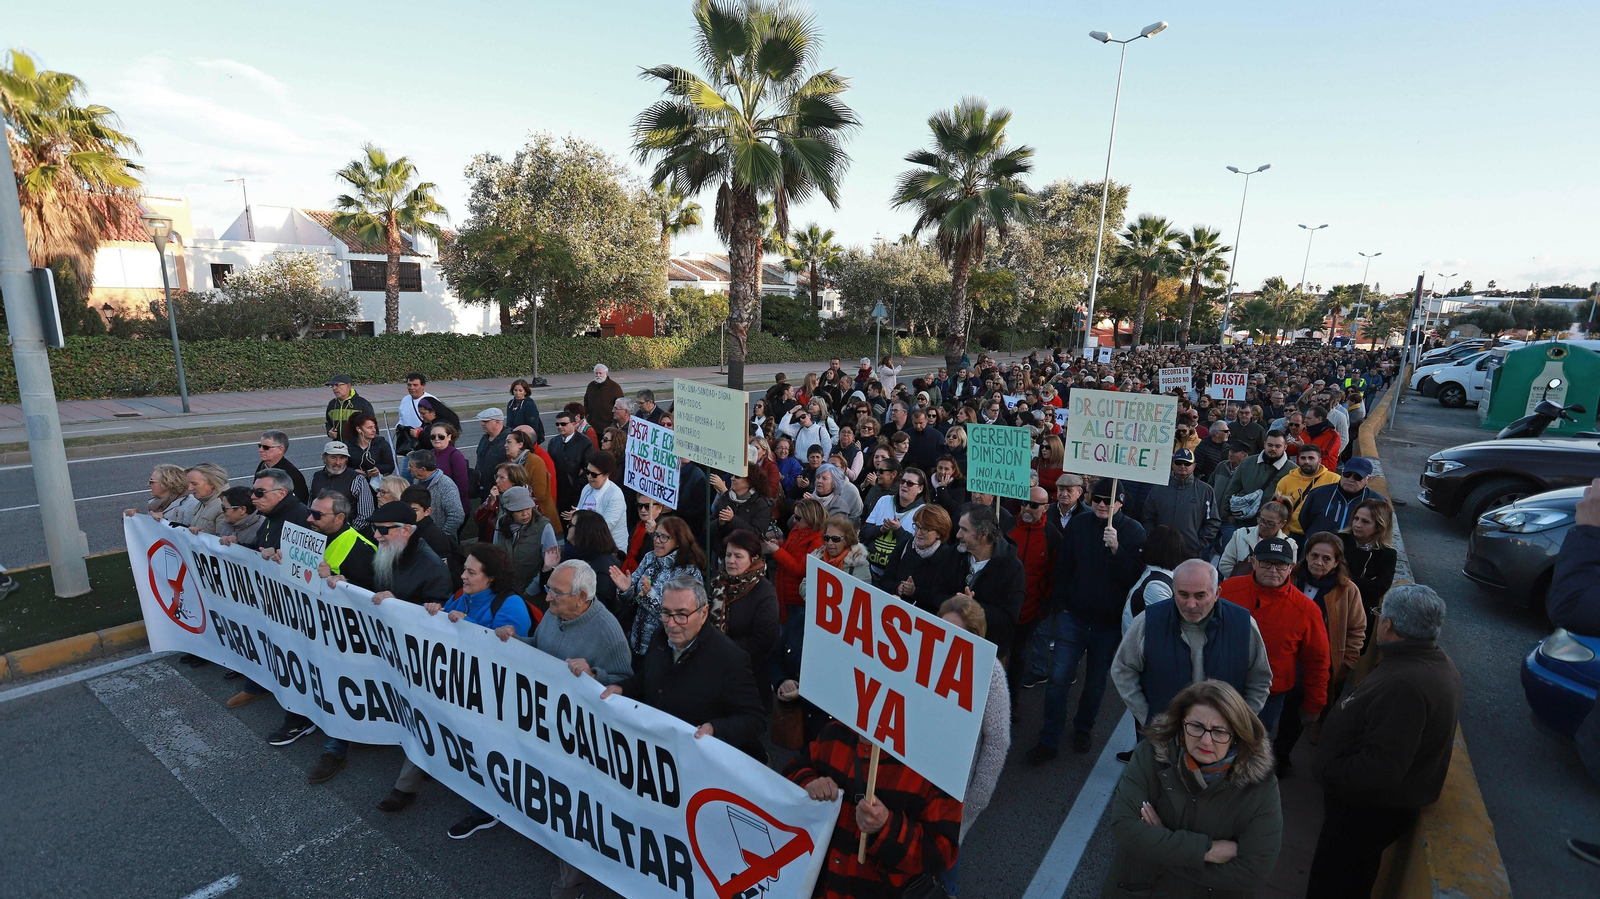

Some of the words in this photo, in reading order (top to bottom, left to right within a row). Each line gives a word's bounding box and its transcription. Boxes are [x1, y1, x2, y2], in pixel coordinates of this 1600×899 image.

[1161, 368, 1182, 376] RECORTA
[1214, 374, 1245, 386] BASTA
[1222, 388, 1234, 399] YA
[651, 427, 660, 447] DE
[971, 427, 1029, 449] GERENTE
[1082, 420, 1170, 444] ALGECIRAS
[630, 439, 635, 454] A
[638, 441, 650, 458] LOS
[1071, 440, 1090, 460] TE
[652, 464, 665, 483] CON
[667, 470, 676, 488] EL
[993, 469, 1002, 479] A
[1004, 470, 1015, 481] LA
[291, 563, 301, 579] DE
[815, 567, 974, 713] BASTA
[191, 550, 227, 599] POR
[223, 559, 260, 610] UNA
[254, 569, 317, 641] SANIDAD
[491, 661, 507, 721] Y
[516, 672, 550, 743] DE
[556, 693, 681, 809] CALIDAD
[853, 666, 906, 758] YA
[208, 609, 262, 666] PARA
[256, 629, 308, 696] TODO
[307, 659, 336, 716] EL
[337, 675, 435, 758] CAMPO
[436, 721, 486, 788] DE
[486, 750, 695, 899] GIBRALTAR
